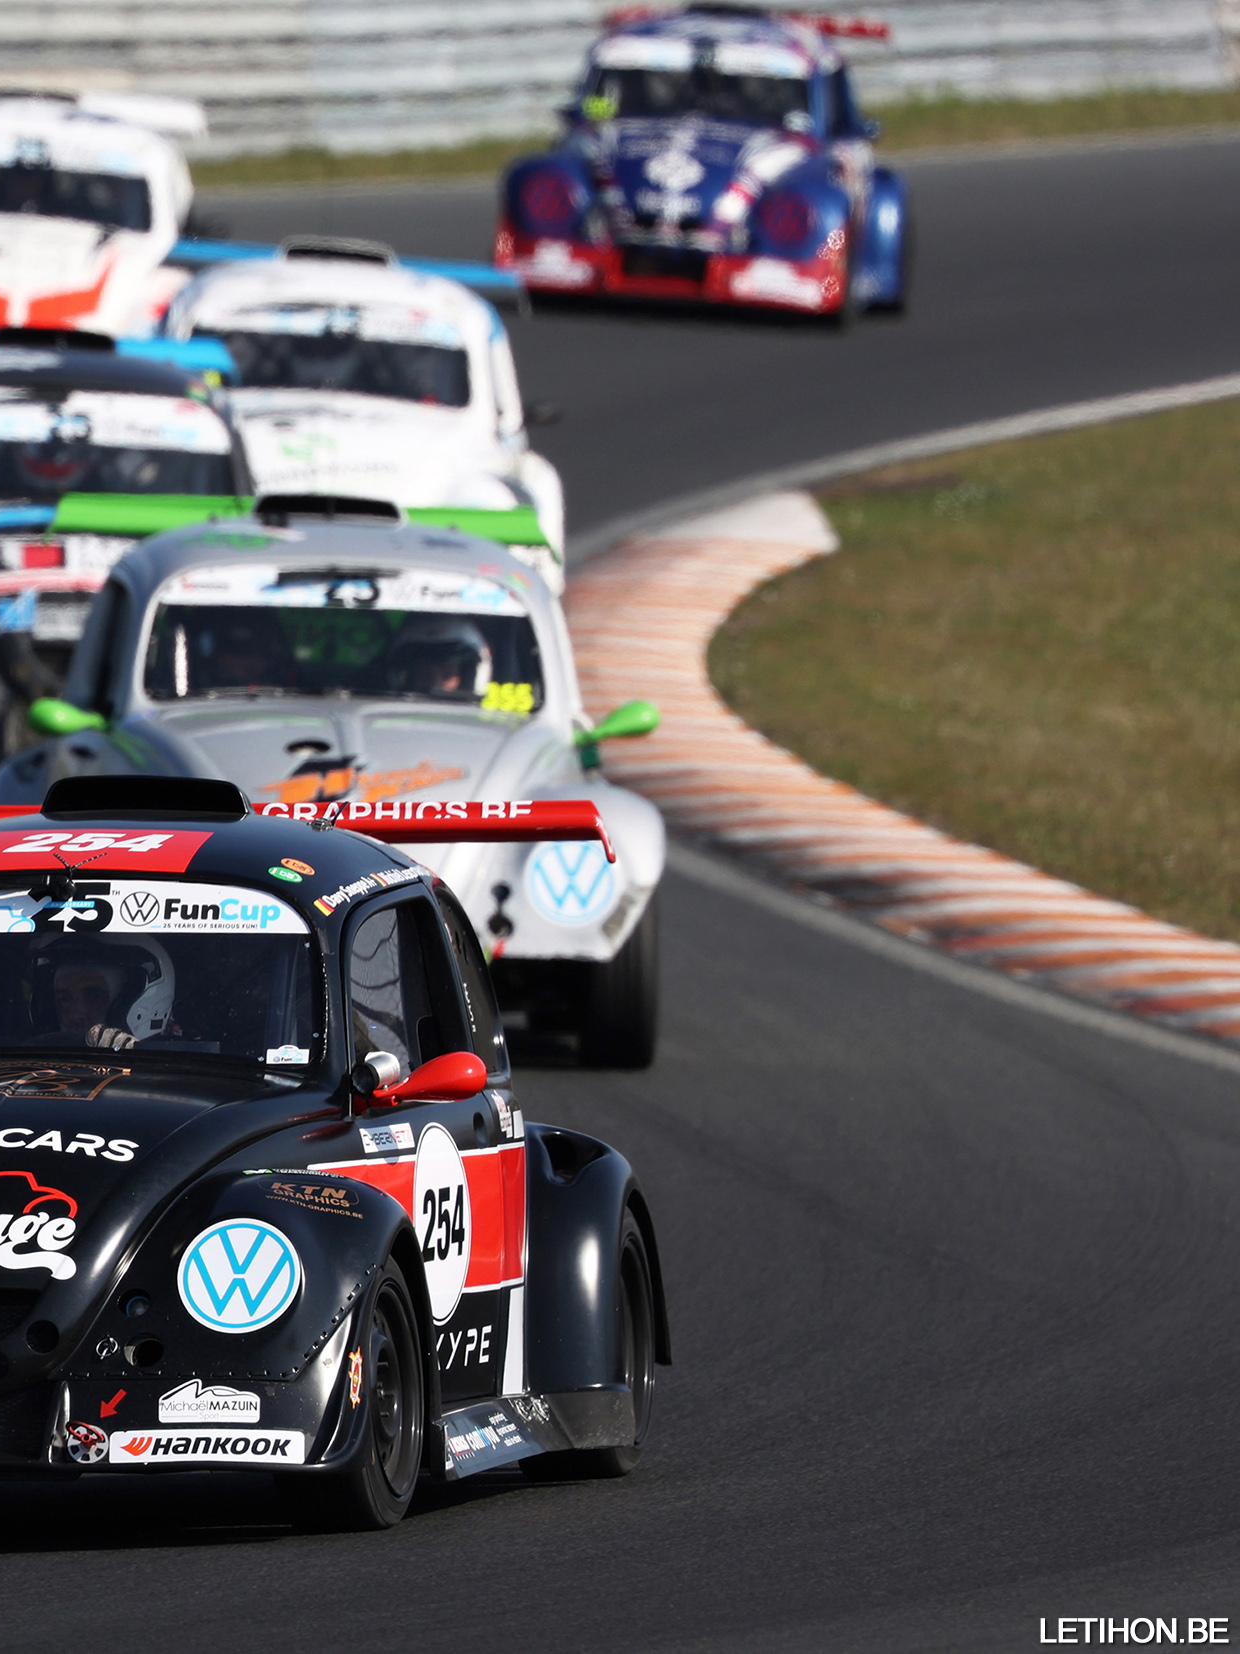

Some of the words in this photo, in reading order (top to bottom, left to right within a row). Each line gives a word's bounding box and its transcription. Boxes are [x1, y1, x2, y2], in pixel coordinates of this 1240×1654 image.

[2, 833, 174, 853] 254
[164, 898, 280, 928] FunCup
[271, 1182, 347, 1199] KTN
[273, 1190, 350, 1207] GRAPHICS
[422, 1184, 465, 1263] 254
